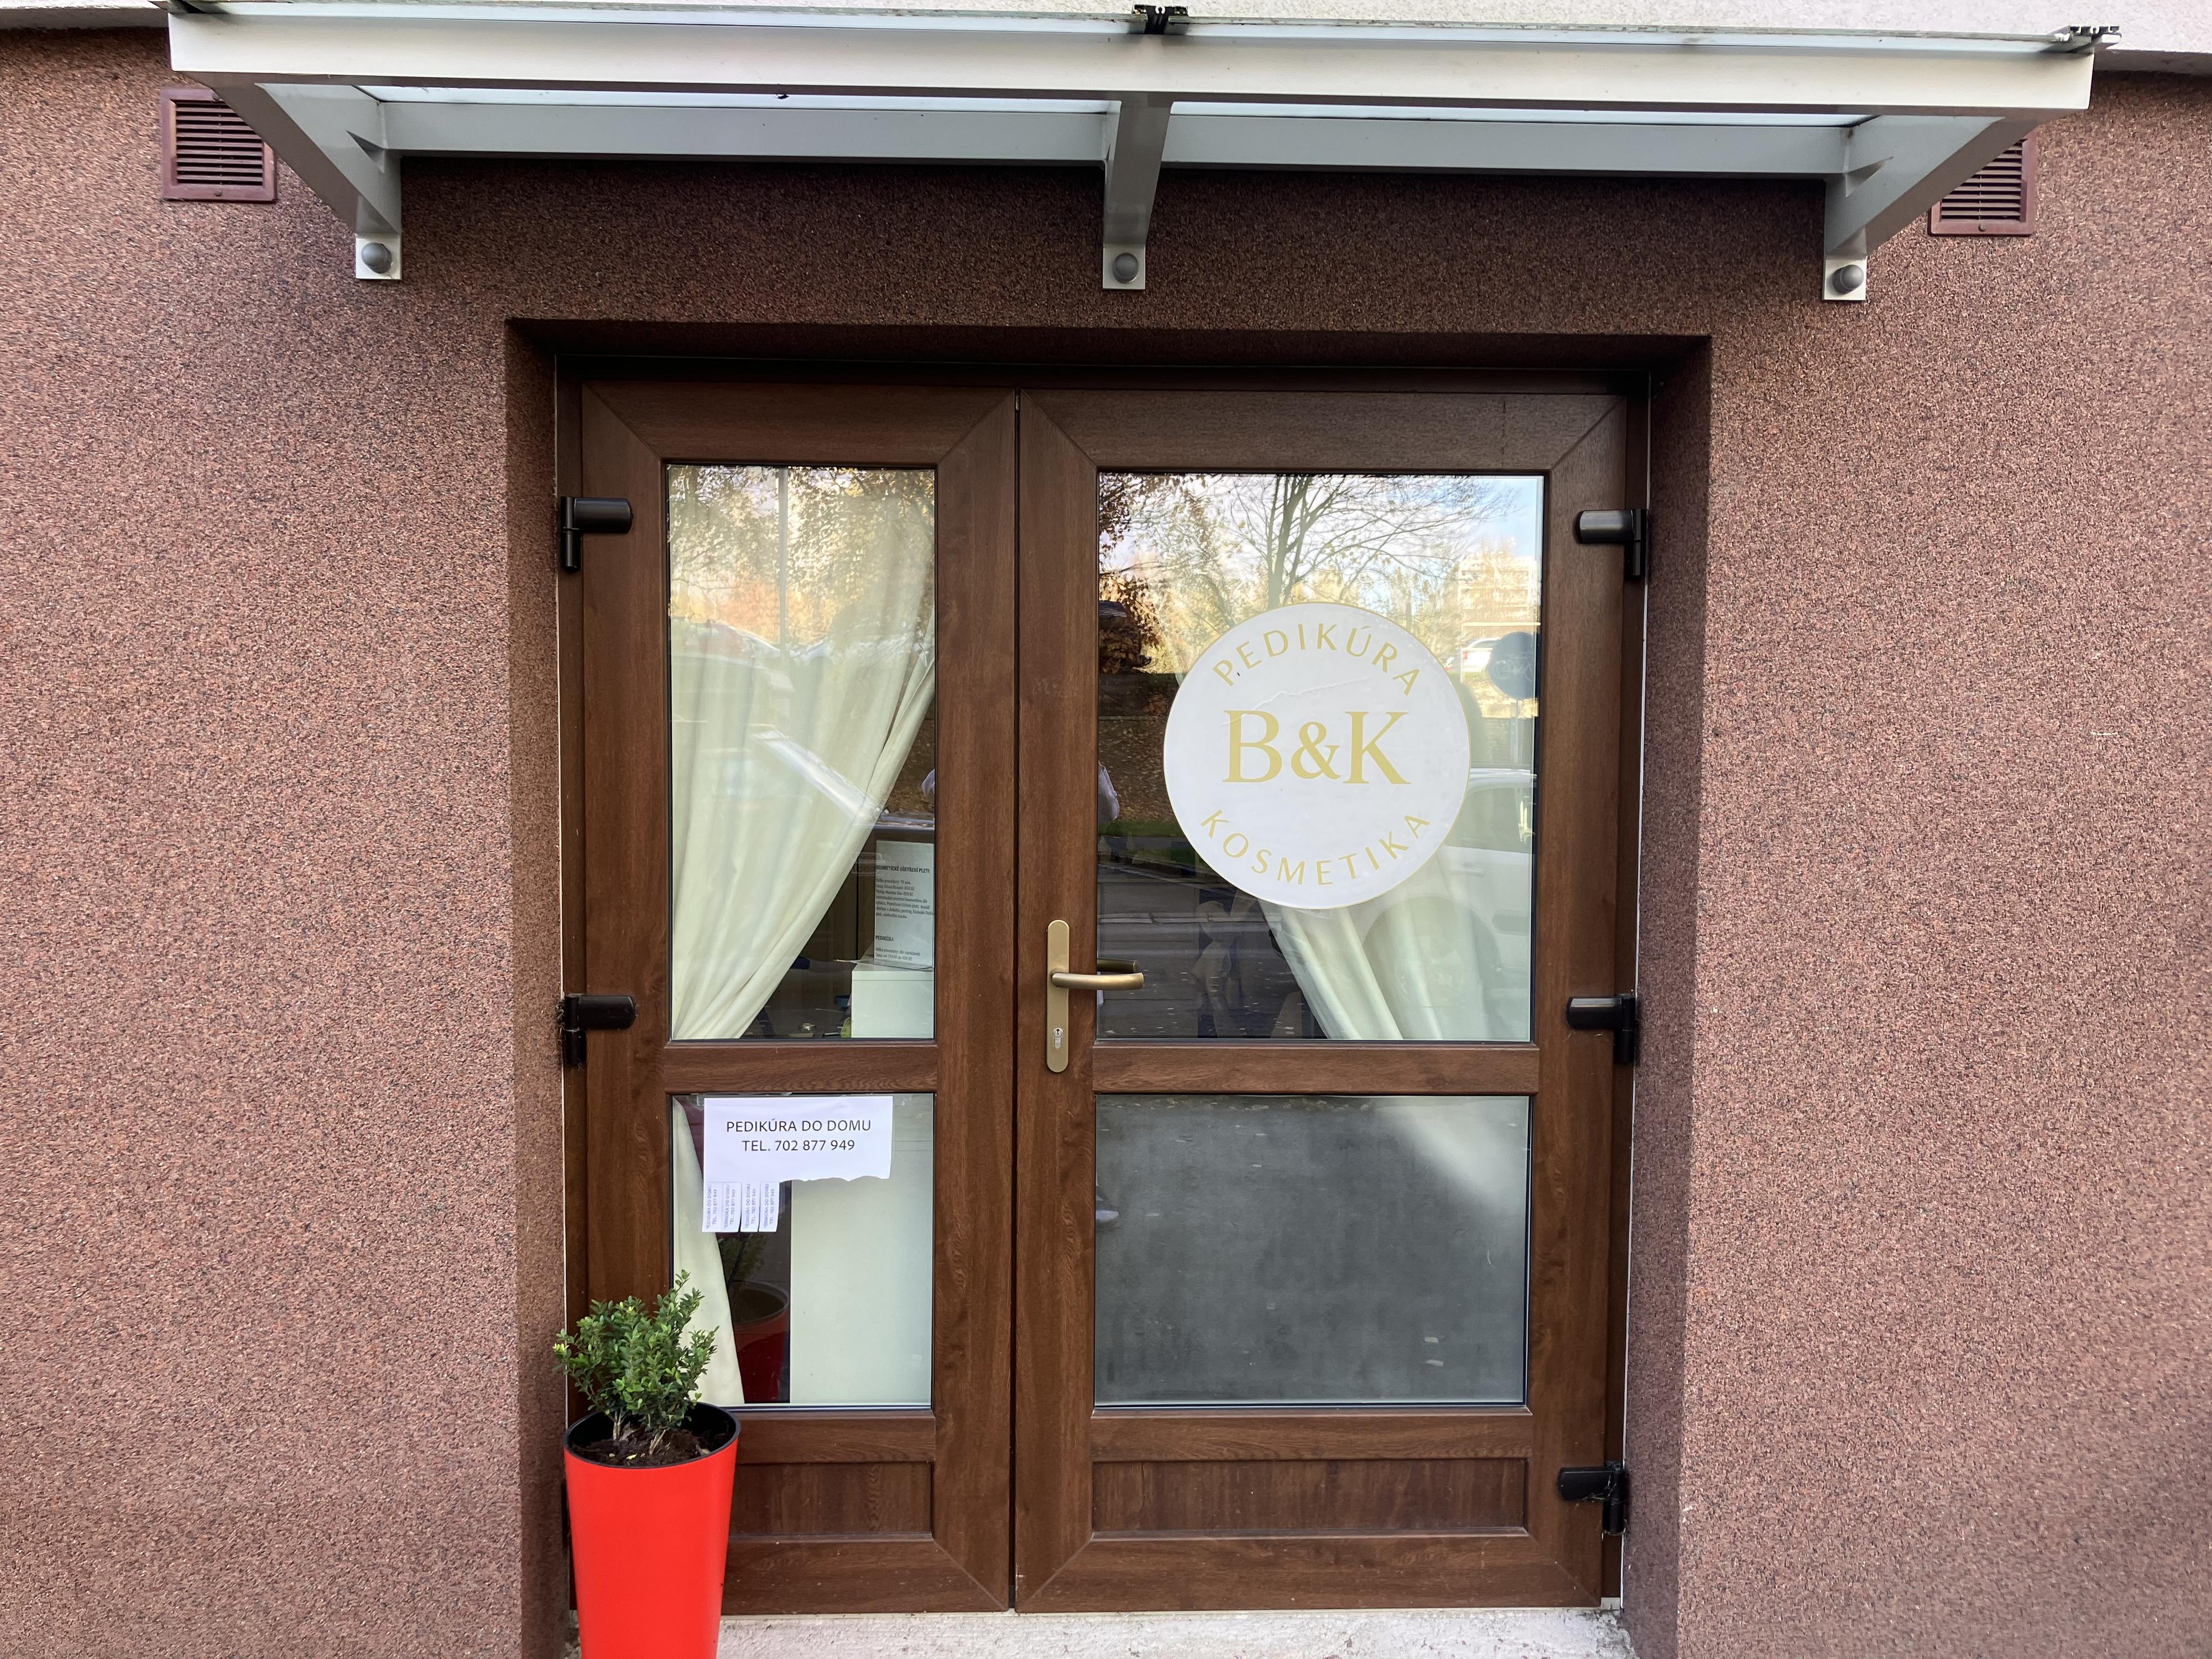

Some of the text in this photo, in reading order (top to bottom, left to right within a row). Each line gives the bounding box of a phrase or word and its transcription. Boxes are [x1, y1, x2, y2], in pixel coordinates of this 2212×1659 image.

[1212, 623, 1420, 696] PEDIKÚRA
[1222, 710, 1411, 784] B&K
[1201, 810, 1430, 885] KOSMETIKA
[726, 1118, 872, 1133] PEDIKÚRA DO DOMU
[742, 1140, 855, 1151] TEL. 702 877 949
